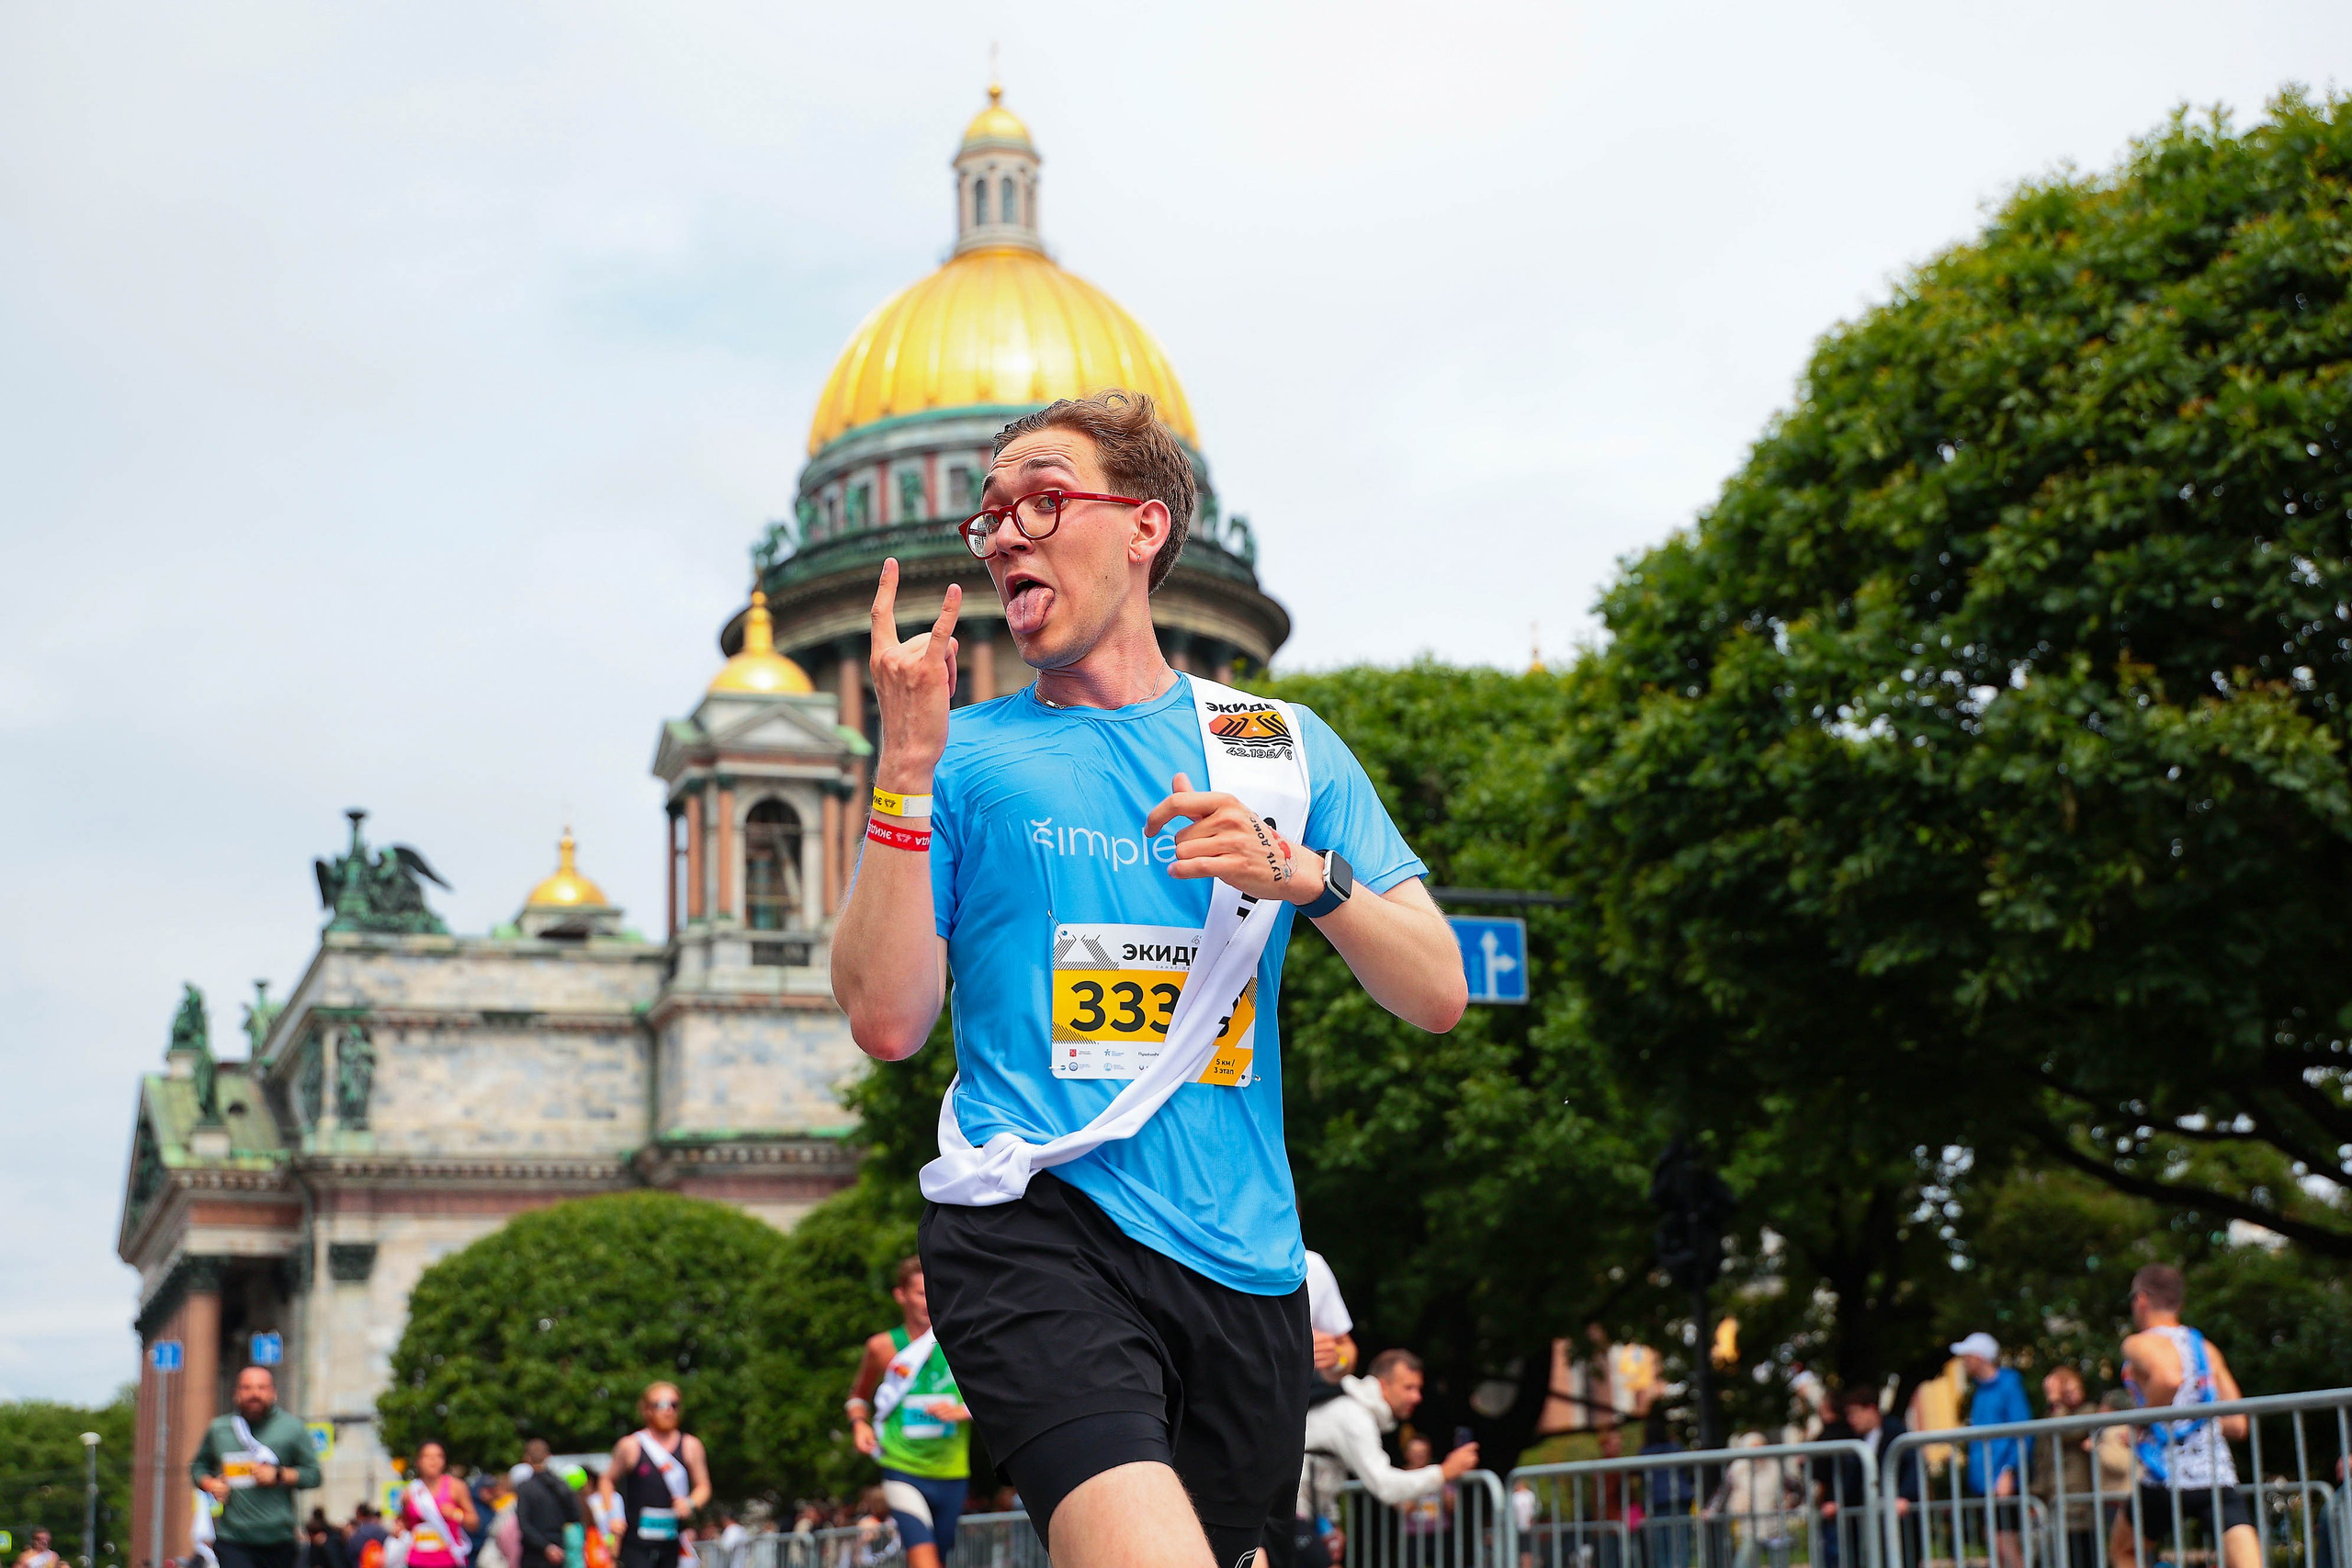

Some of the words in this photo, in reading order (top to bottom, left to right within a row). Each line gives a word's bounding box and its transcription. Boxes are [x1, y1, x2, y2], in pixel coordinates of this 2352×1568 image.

[1250, 812, 1272, 847] ДОМО
[1267, 852, 1283, 882] ПУТЬ
[1069, 980, 1230, 1039] 333
